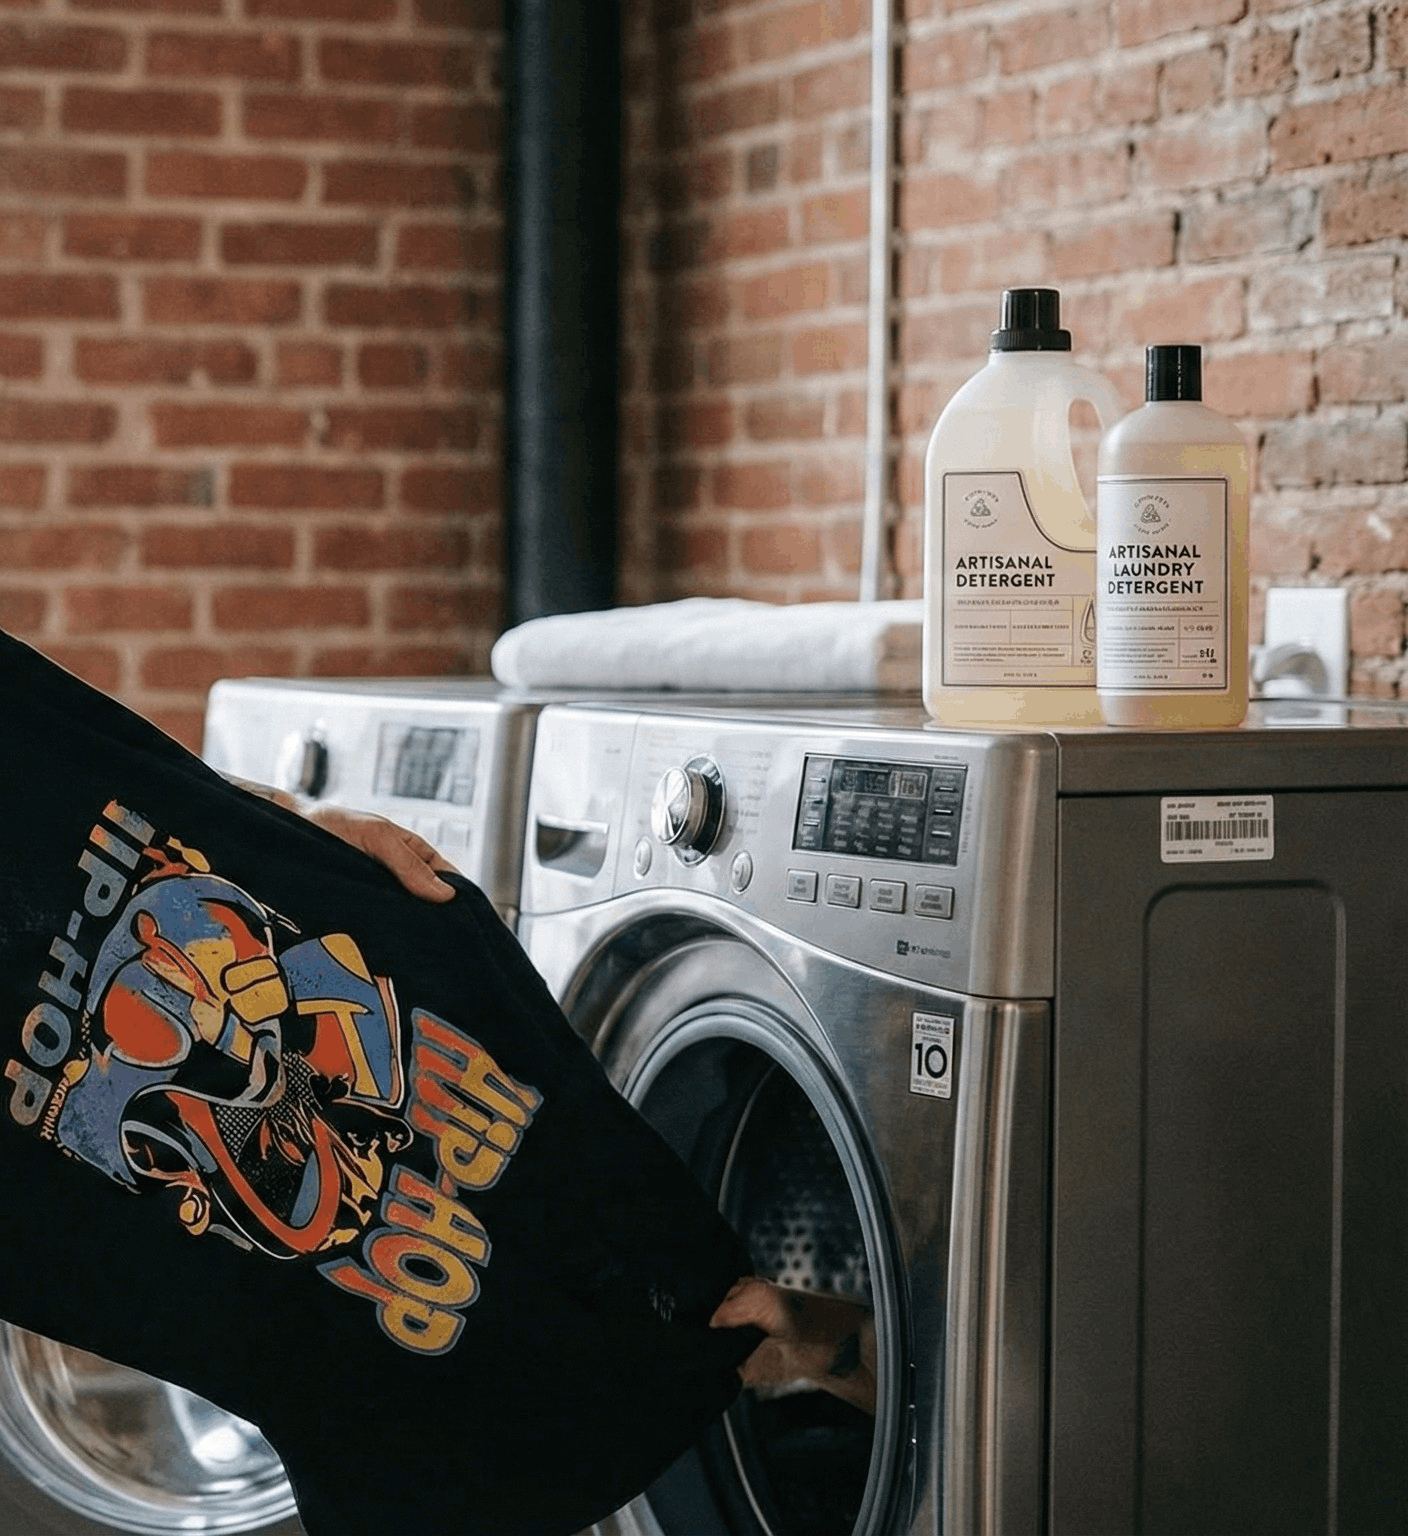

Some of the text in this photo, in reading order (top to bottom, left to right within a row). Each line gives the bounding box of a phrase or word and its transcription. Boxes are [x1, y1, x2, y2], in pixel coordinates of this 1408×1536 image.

[1108, 544, 1202, 559] ARTISANAL
[955, 556, 1053, 570] ARTISANAL
[1114, 562, 1195, 577] LAUNDRY
[955, 574, 1056, 588] DETERGENT
[1108, 580, 1204, 595] DETERGENT
[914, 1042, 948, 1079] 10
